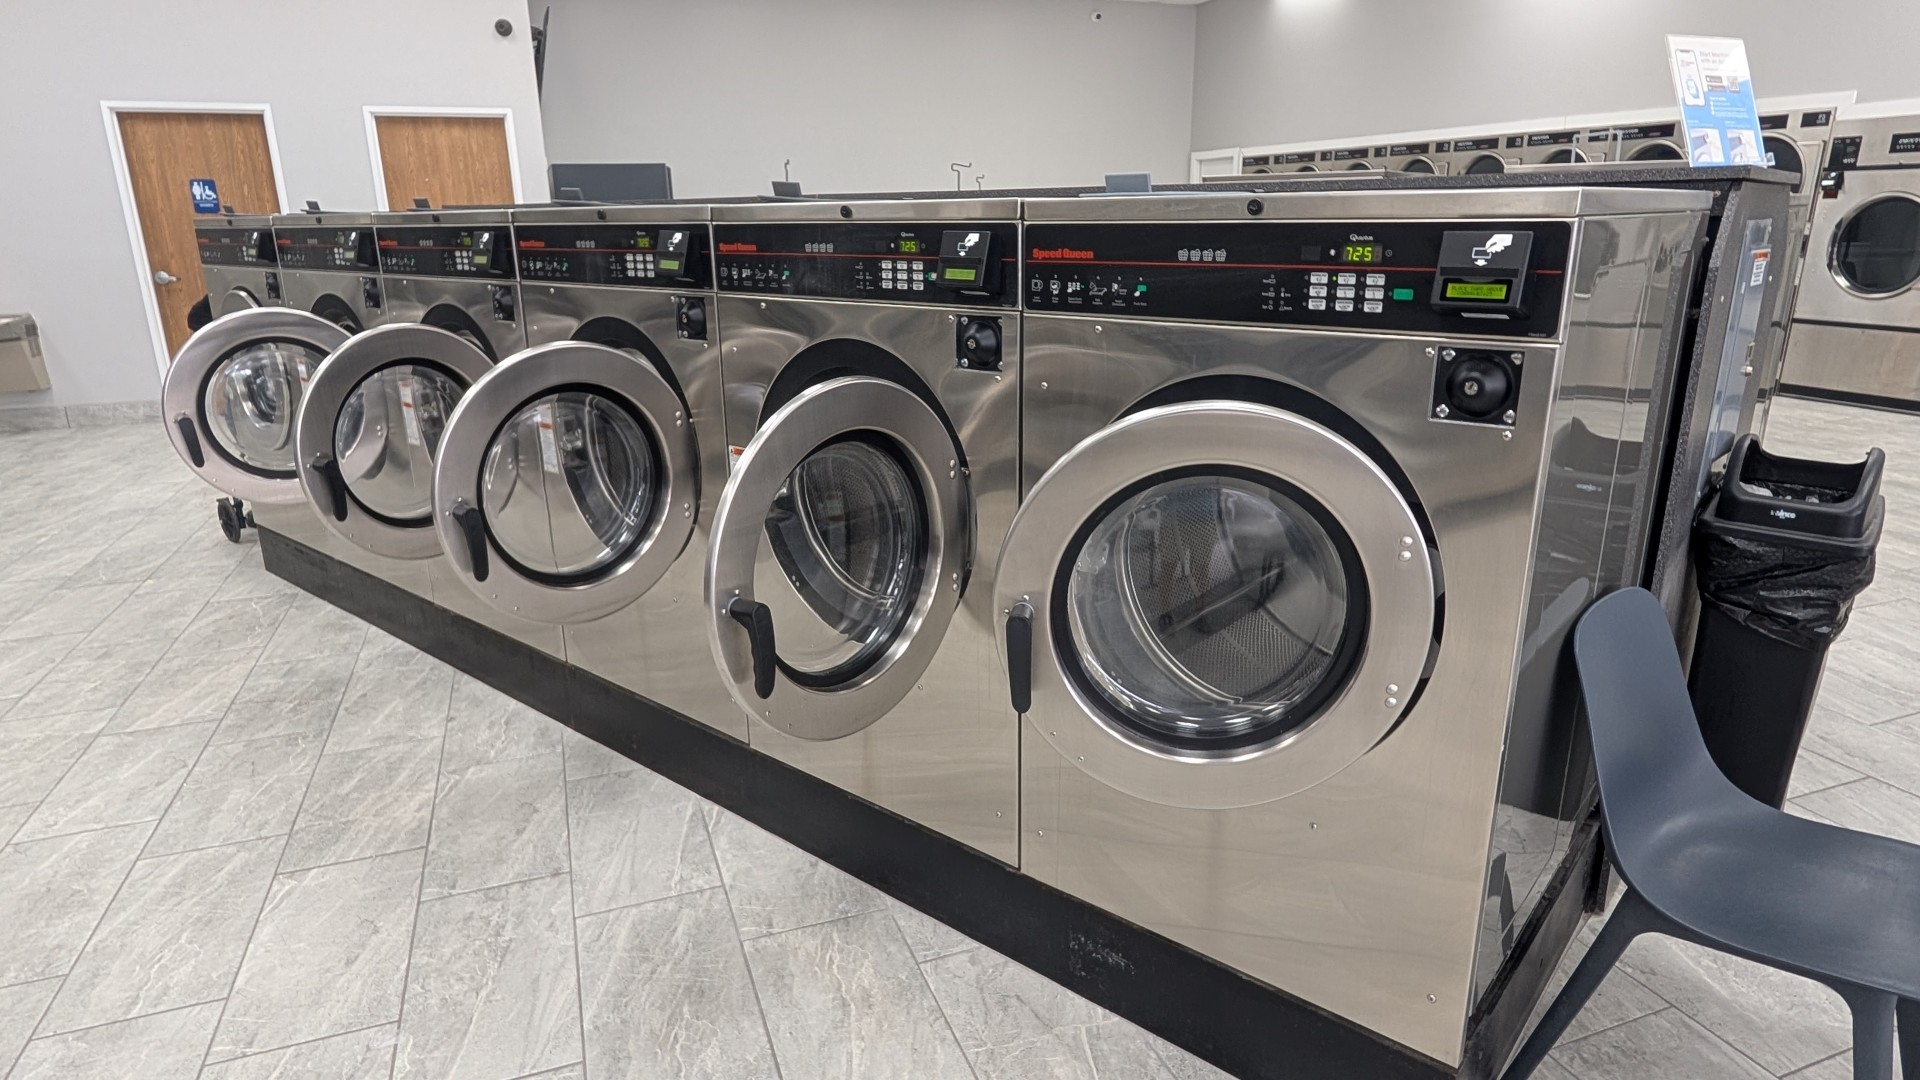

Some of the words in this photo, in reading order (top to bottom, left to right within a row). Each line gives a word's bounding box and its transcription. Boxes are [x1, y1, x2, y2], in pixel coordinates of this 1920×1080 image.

[900, 241, 916, 252] 725
[1032, 248, 1061, 259] Speed
[1062, 248, 1094, 258] Queen
[1346, 246, 1372, 261] 725
